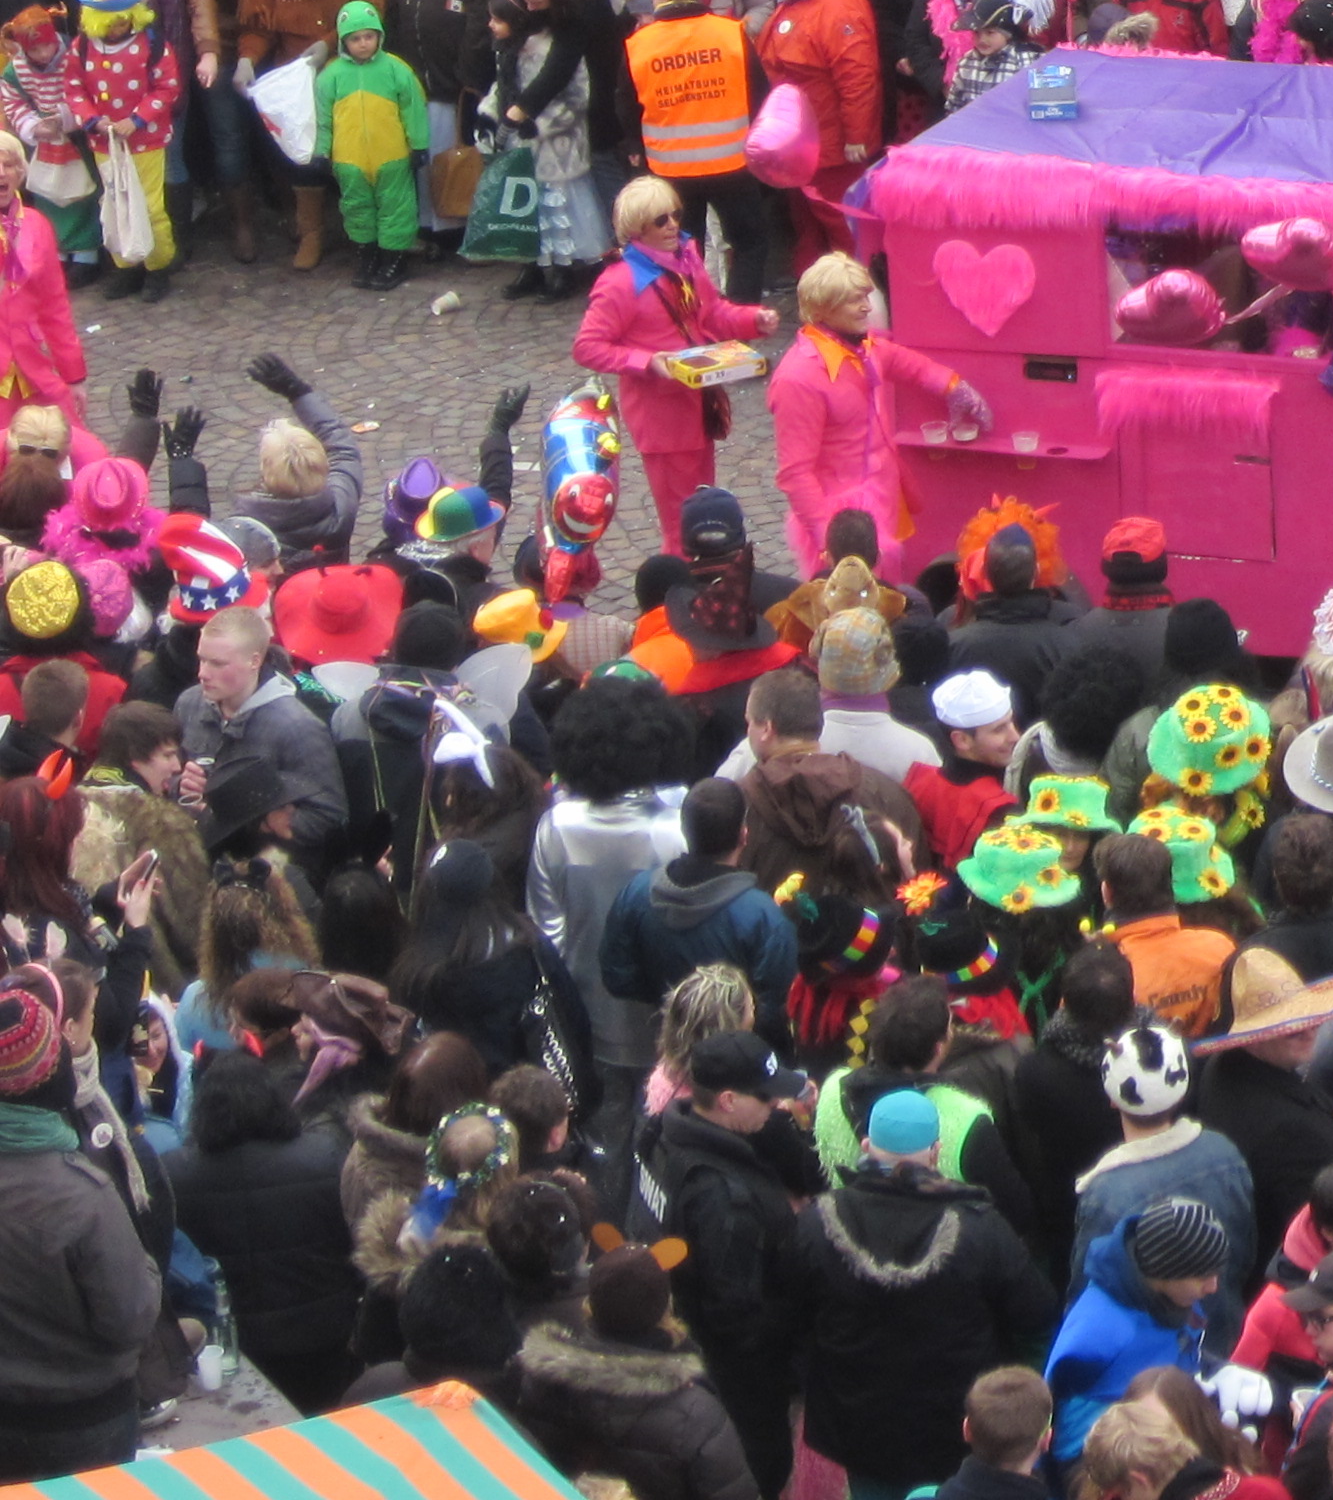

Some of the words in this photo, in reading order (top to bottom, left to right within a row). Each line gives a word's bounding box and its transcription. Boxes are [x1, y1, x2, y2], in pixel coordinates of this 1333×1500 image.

[651, 48, 722, 73] ORDNER
[655, 77, 725, 97] HEIMATBUND
[657, 89, 727, 109] SELIGENSTADT
[500, 176, 538, 217] D
